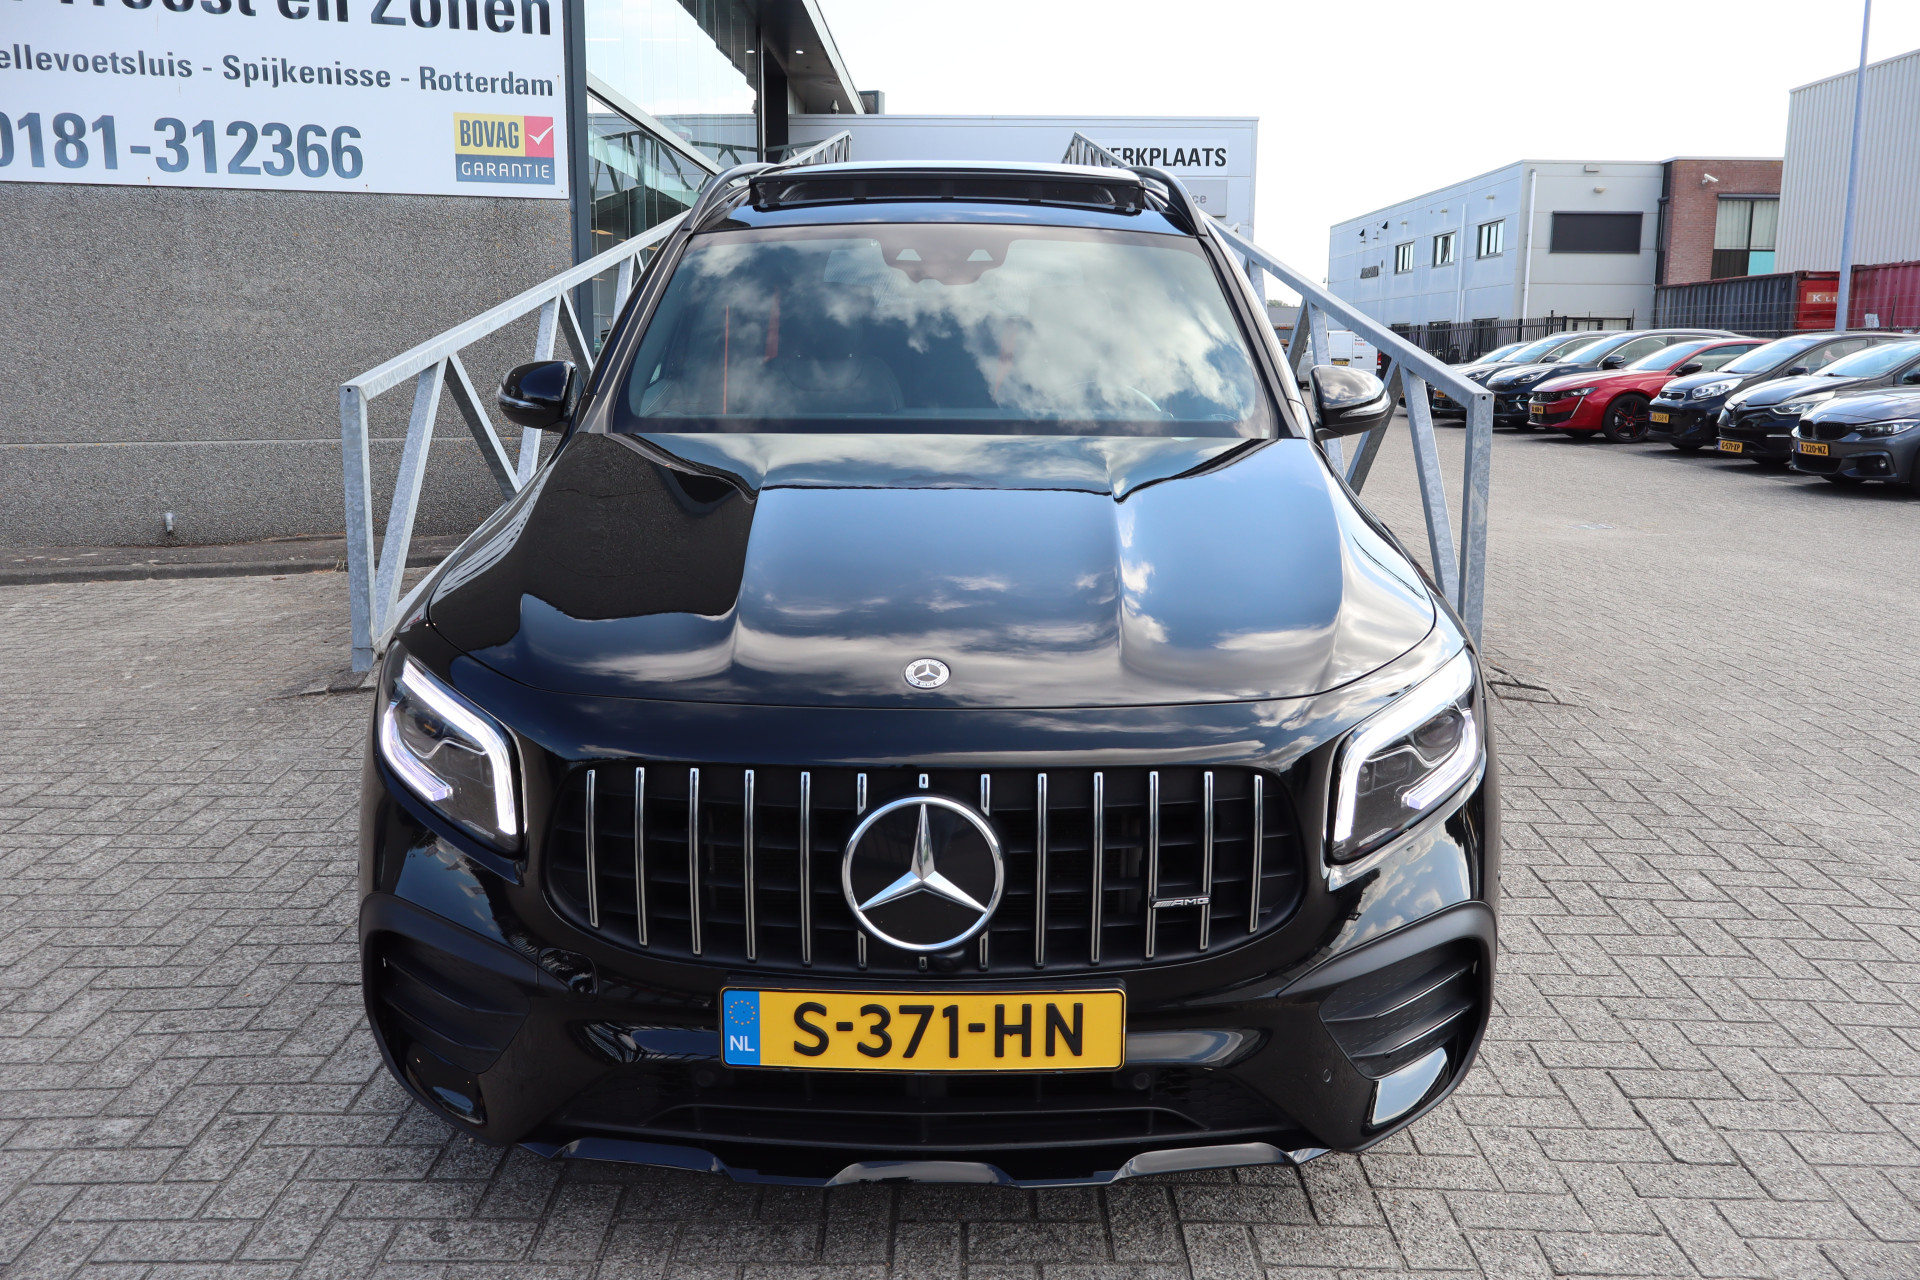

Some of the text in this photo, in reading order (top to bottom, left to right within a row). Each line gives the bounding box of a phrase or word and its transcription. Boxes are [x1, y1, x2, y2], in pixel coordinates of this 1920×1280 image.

[222, 54, 391, 88] Spijkenisse
[419, 66, 553, 97] Rotterdam
[459, 119, 520, 149] BOVAG
[461, 161, 551, 179] GARANTIE
[1171, 897, 1209, 906] AMG
[793, 1001, 1084, 1059] S-371-HN
[729, 1035, 756, 1052] NL
